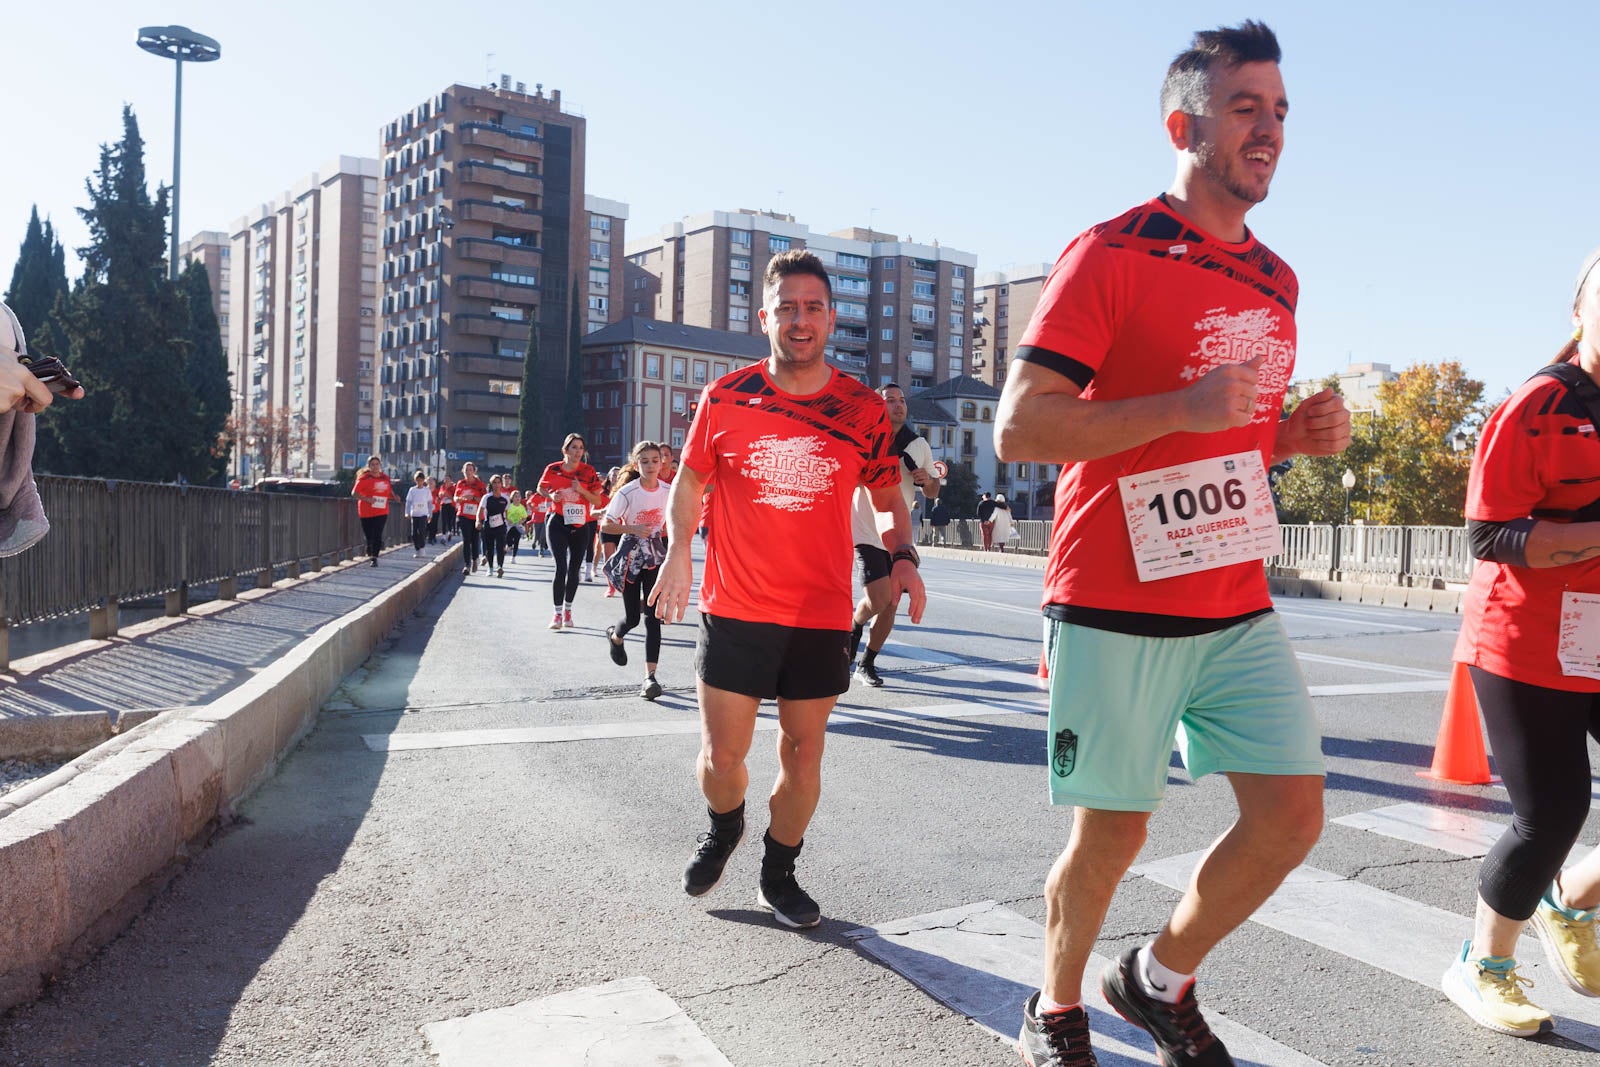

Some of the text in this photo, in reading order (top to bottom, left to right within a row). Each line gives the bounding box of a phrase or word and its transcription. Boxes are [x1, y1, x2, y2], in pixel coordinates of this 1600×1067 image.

[1199, 334, 1290, 368] carrera
[750, 451, 831, 476] carrera
[750, 467, 829, 489] cruzroja.es
[1148, 478, 1247, 526] 1006
[1166, 515, 1249, 541] RAZA GUERRERA
